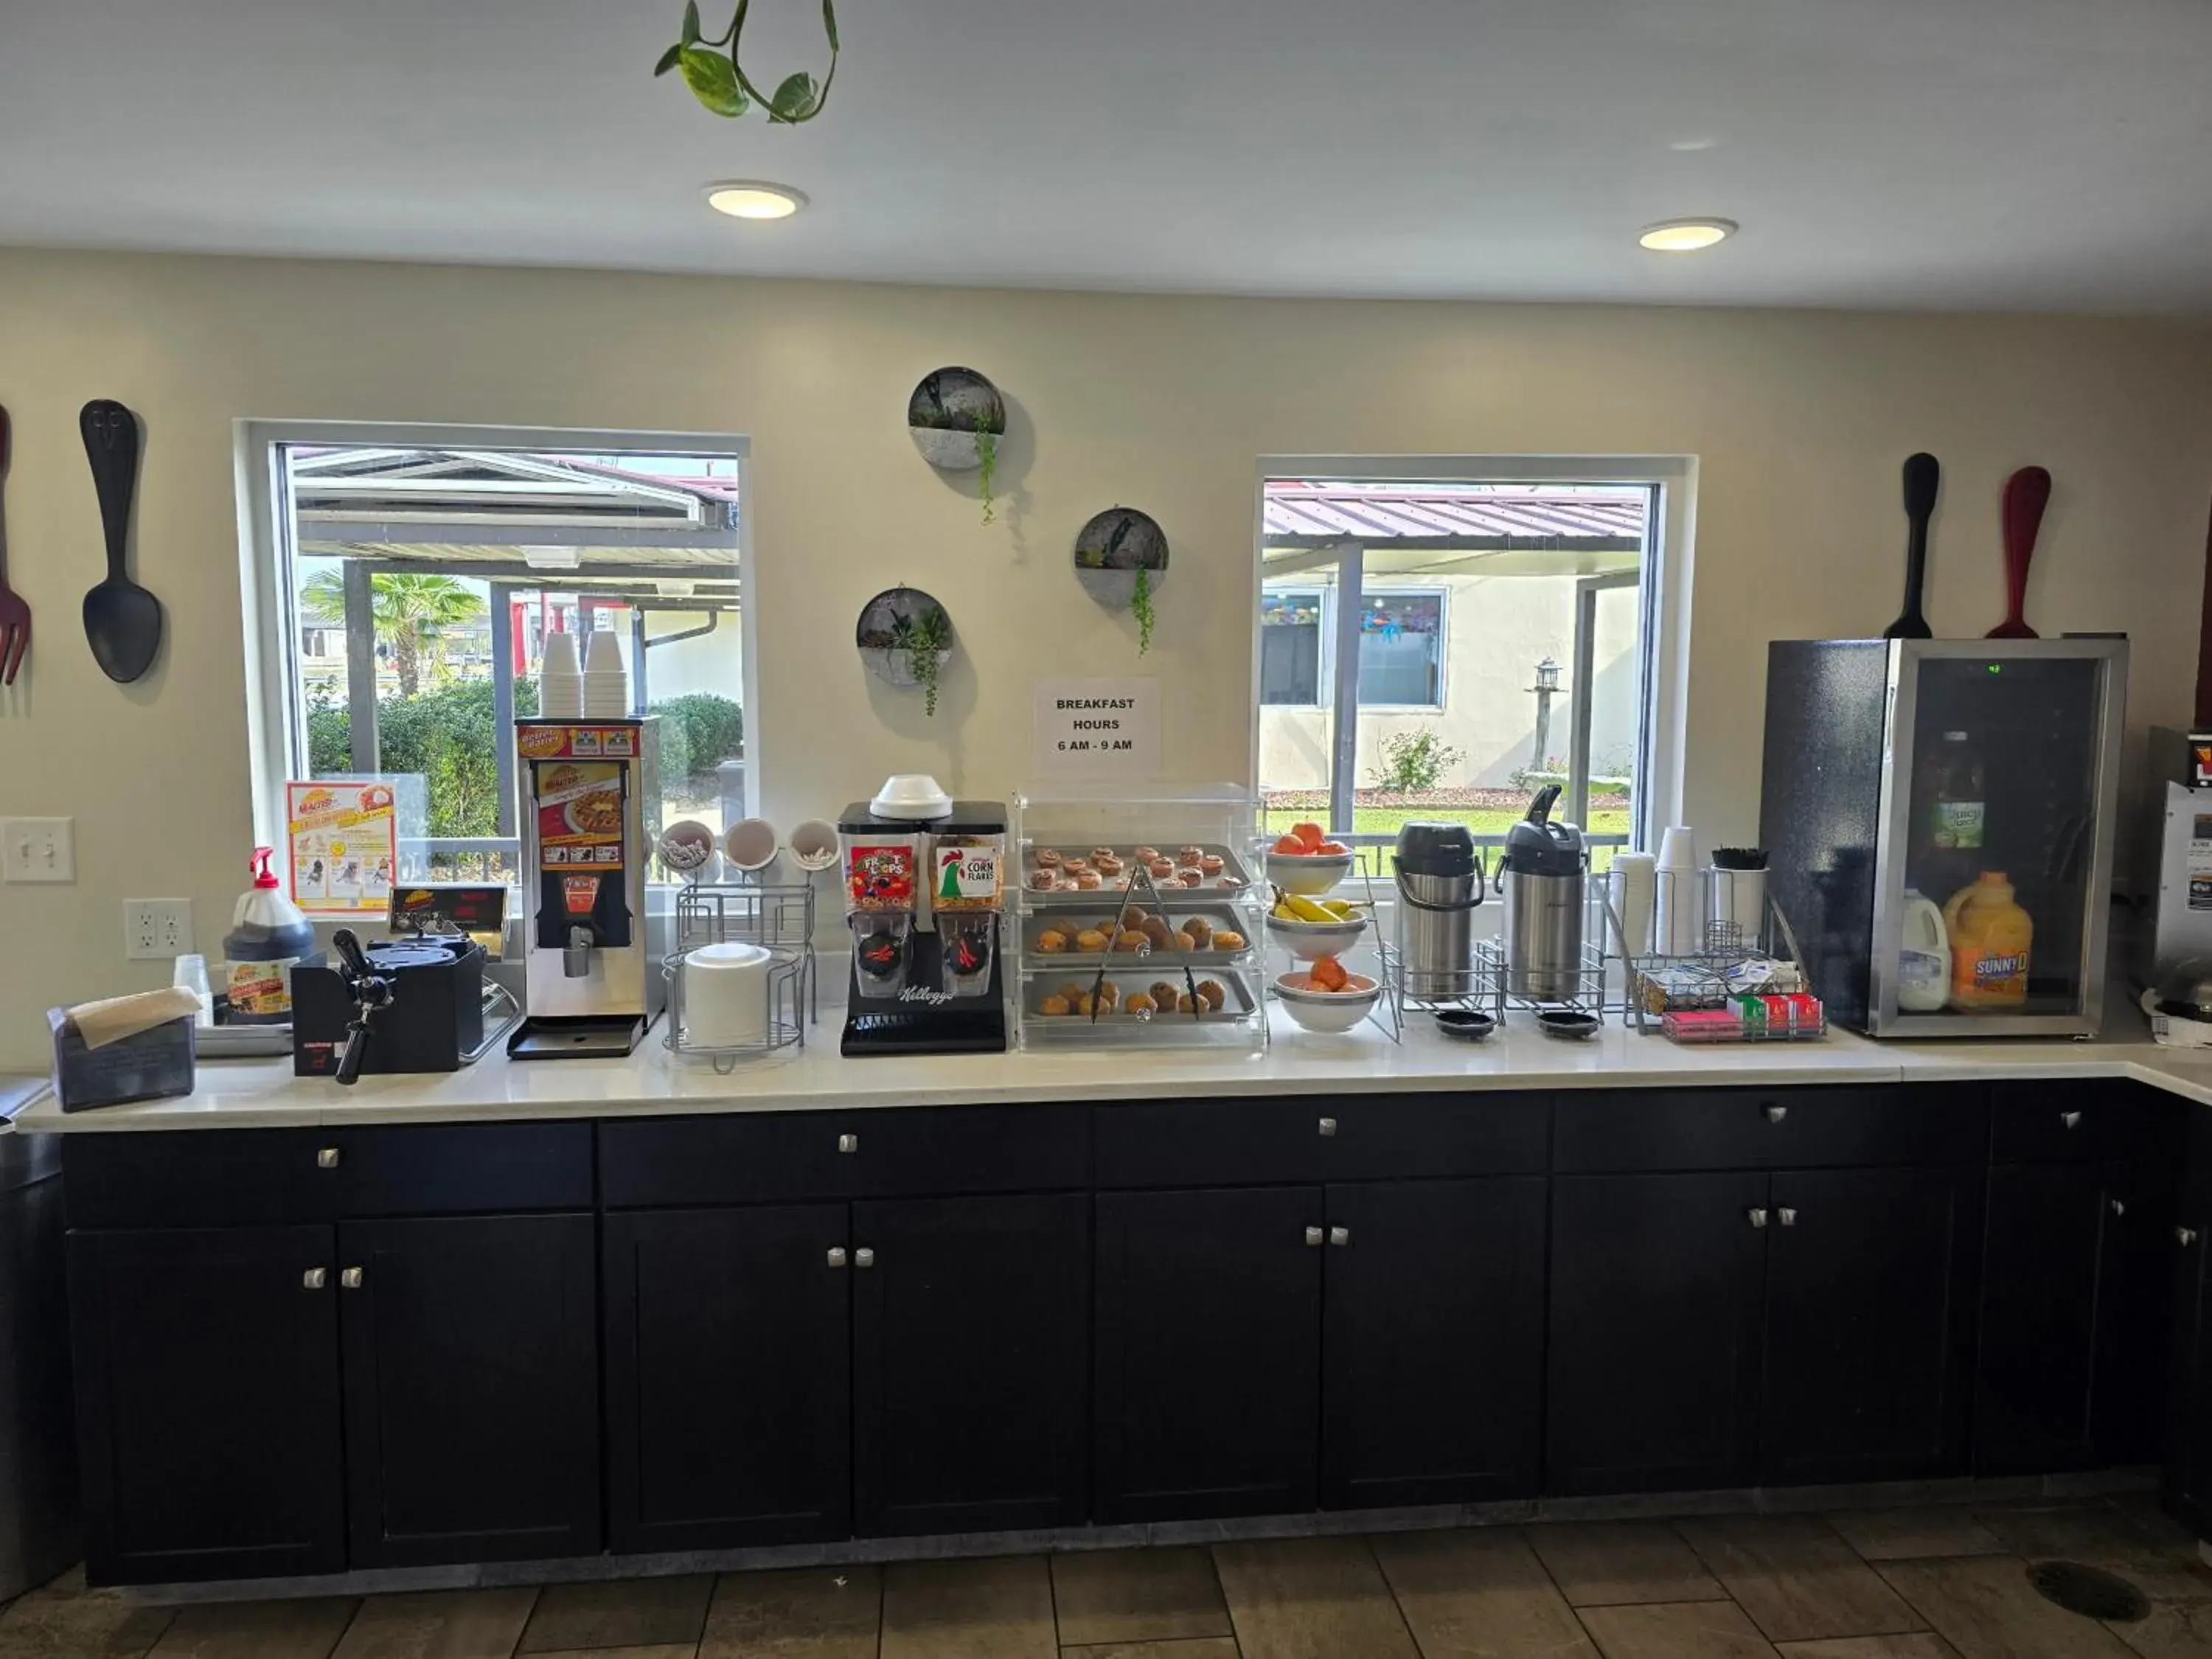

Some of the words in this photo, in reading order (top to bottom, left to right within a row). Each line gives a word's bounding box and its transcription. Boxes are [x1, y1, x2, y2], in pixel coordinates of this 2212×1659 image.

[1057, 699, 1134, 709] BREAKFAST
[1074, 720, 1119, 729] HOURS
[1058, 741, 1065, 751] 6
[1070, 741, 1089, 750] AM
[1101, 740, 1108, 750] 9
[1113, 740, 1132, 749] AM
[967, 861, 993, 872] CORN
